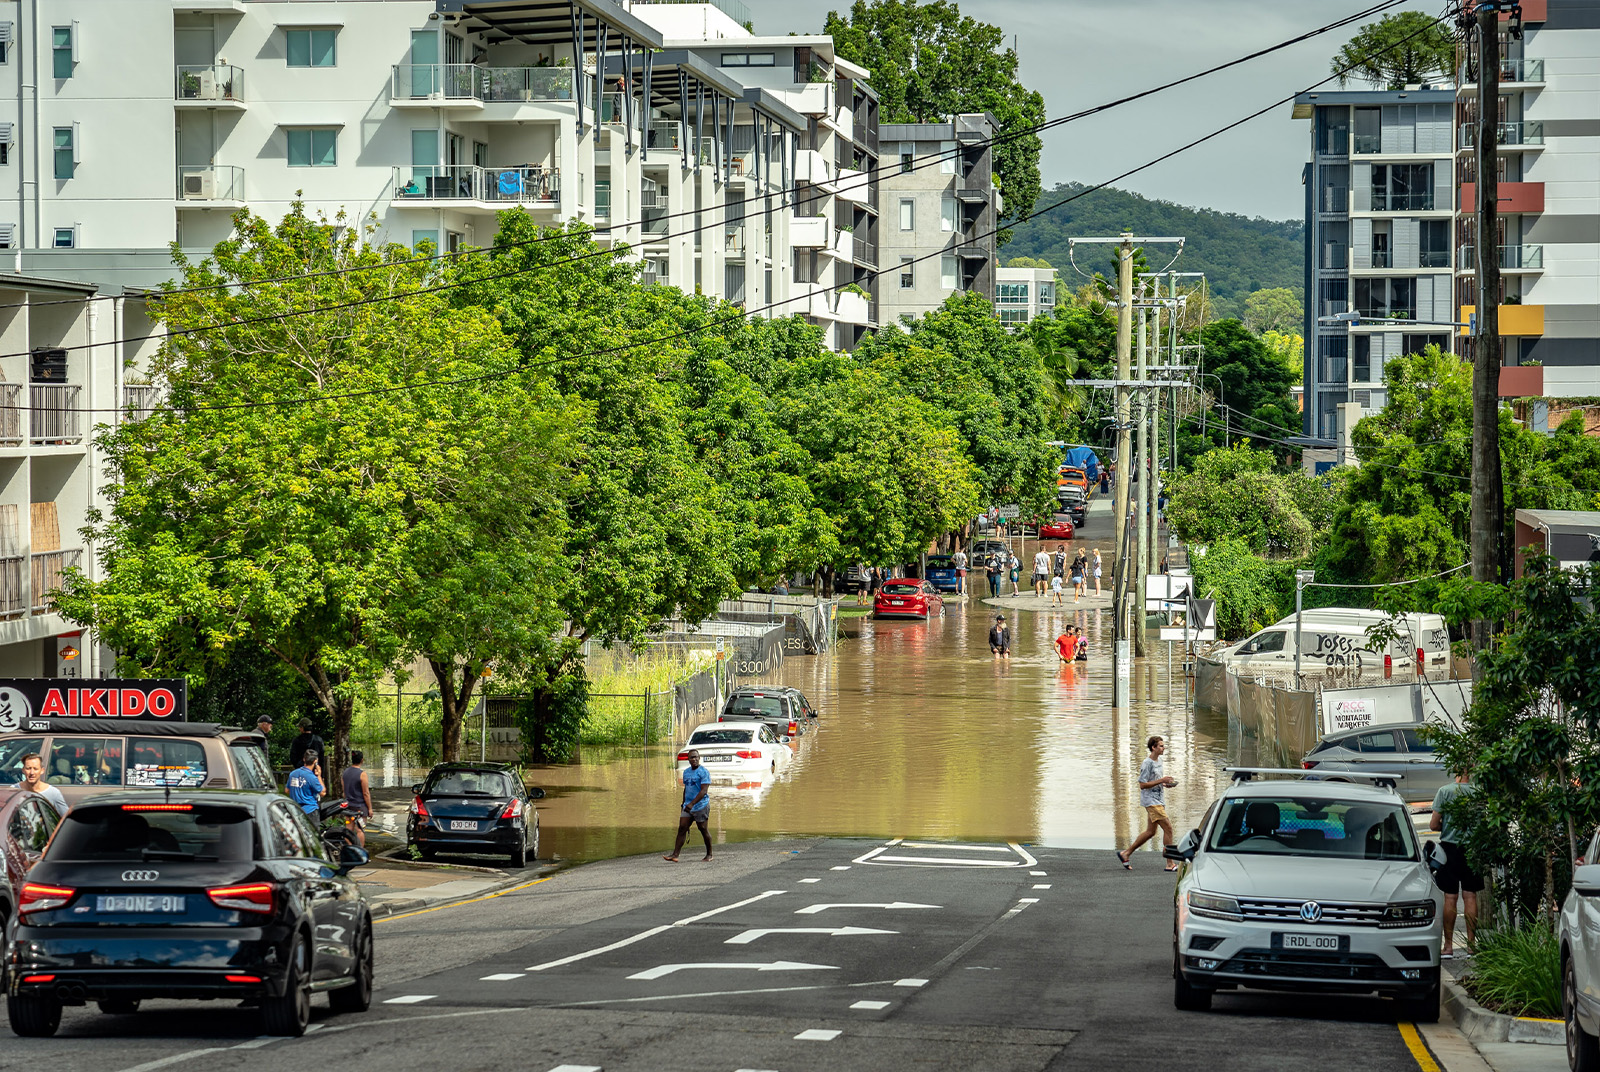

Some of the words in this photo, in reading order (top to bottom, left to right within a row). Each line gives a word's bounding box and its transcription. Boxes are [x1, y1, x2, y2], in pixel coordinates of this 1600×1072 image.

[1316, 634, 1352, 655] roses
[734, 660, 763, 673] 1300
[62, 666, 76, 678] 14
[40, 688, 175, 717] AIKIDO
[1342, 701, 1365, 710] RCC
[1335, 713, 1372, 722] MONTAGUE
[31, 721, 48, 730] XTM
[1337, 720, 1370, 729] MARKETS
